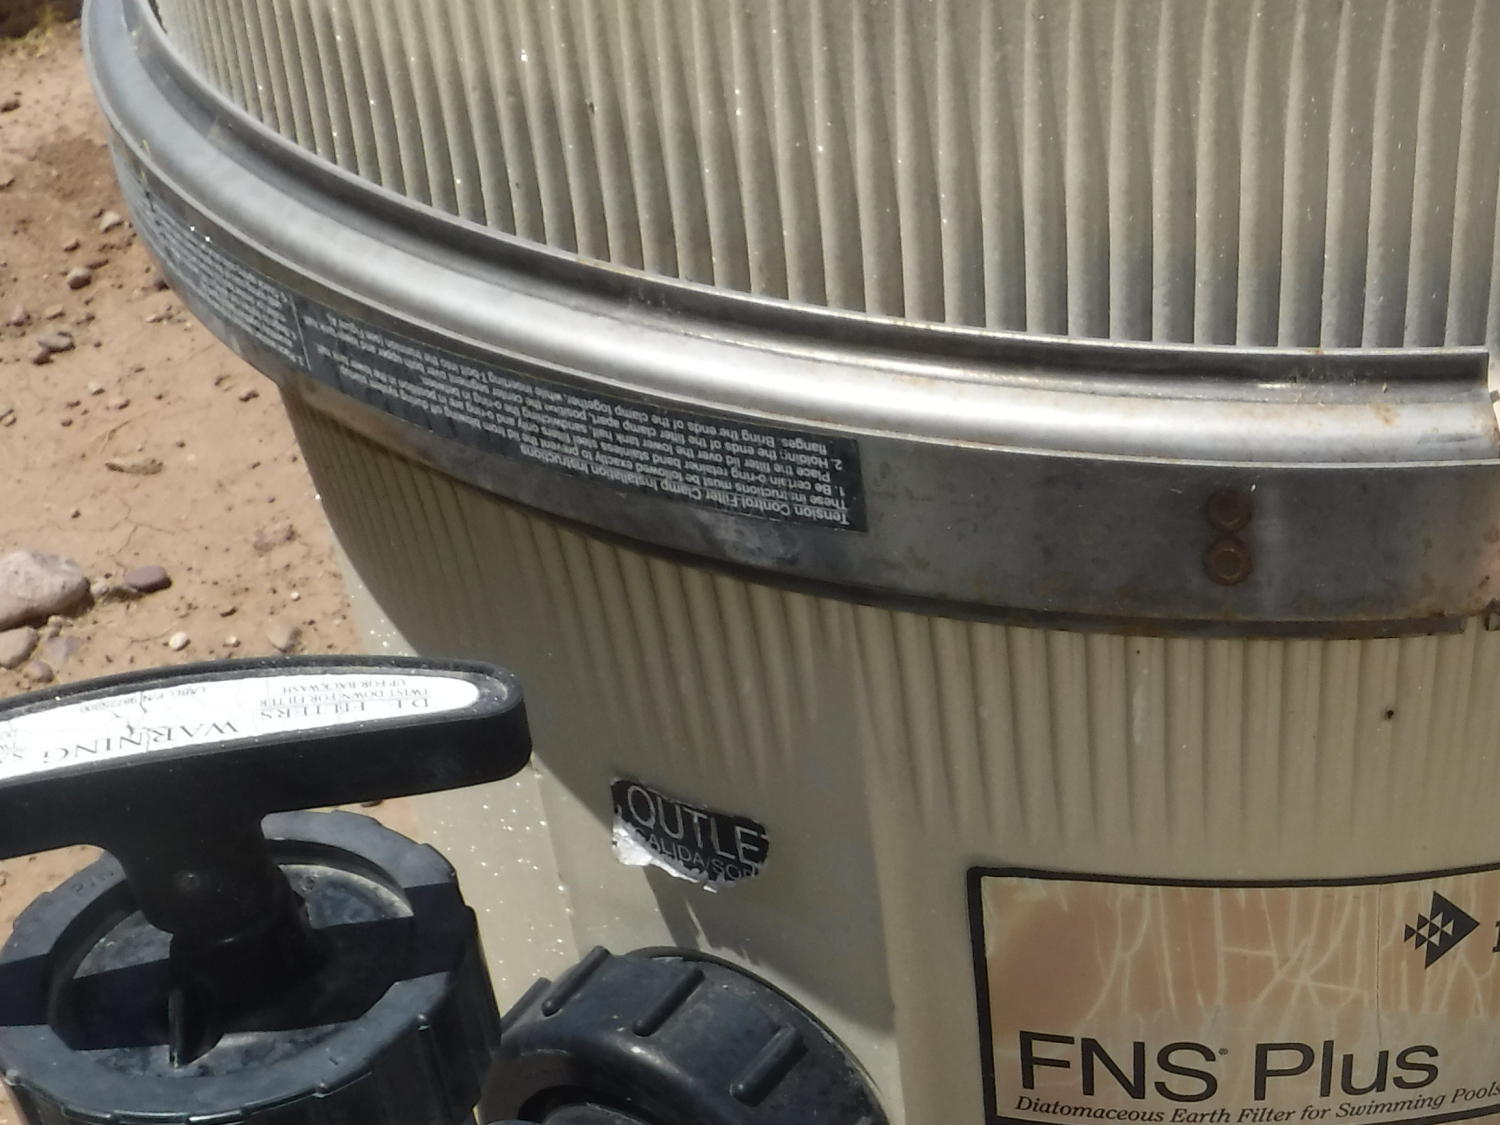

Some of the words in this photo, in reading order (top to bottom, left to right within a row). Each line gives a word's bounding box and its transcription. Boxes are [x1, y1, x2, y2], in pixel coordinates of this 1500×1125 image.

[614, 405, 649, 422] clamp
[651, 414, 671, 428] the
[622, 420, 657, 437] clamp
[672, 419, 685, 431] of
[687, 422, 717, 435] ends
[660, 430, 685, 444] filter
[719, 428, 739, 440] the
[741, 429, 775, 448] Bring
[642, 439, 674, 455] lower
[687, 435, 708, 449] the
[710, 439, 722, 451] of
[724, 440, 755, 455] ends
[520, 444, 589, 474] Instructions
[581, 449, 593, 461] to
[675, 445, 695, 459] the
[697, 451, 723, 462] over
[757, 447, 777, 460] the
[779, 449, 829, 469] Holding
[595, 451, 633, 470] exactly
[652, 453, 682, 470] band
[725, 455, 741, 466] lid
[743, 459, 770, 473] filter
[635, 463, 683, 482] followed
[684, 460, 729, 477] retainer
[731, 467, 767, 483] o-ring
[773, 463, 793, 476] the
[796, 467, 830, 483] Place
[589, 465, 658, 491] Installation
[685, 474, 700, 486] be
[703, 477, 731, 491] must
[770, 476, 812, 490] certain
[660, 480, 702, 500] Clamp
[735, 482, 806, 504] instructions
[814, 483, 832, 496] Be
[834, 485, 846, 497] 1.
[705, 490, 738, 507] Filter
[810, 496, 848, 510] These
[741, 497, 790, 516] Control
[794, 506, 850, 526] Tension
[1253, 1039, 1439, 1102] Plus
[1015, 1095, 1165, 1122] Diatomaceous
[1170, 1108, 1231, 1123] Earth
[1237, 1106, 1296, 1123] Filter
[1299, 1104, 1332, 1122] for
[1336, 1093, 1446, 1119] Swimming
